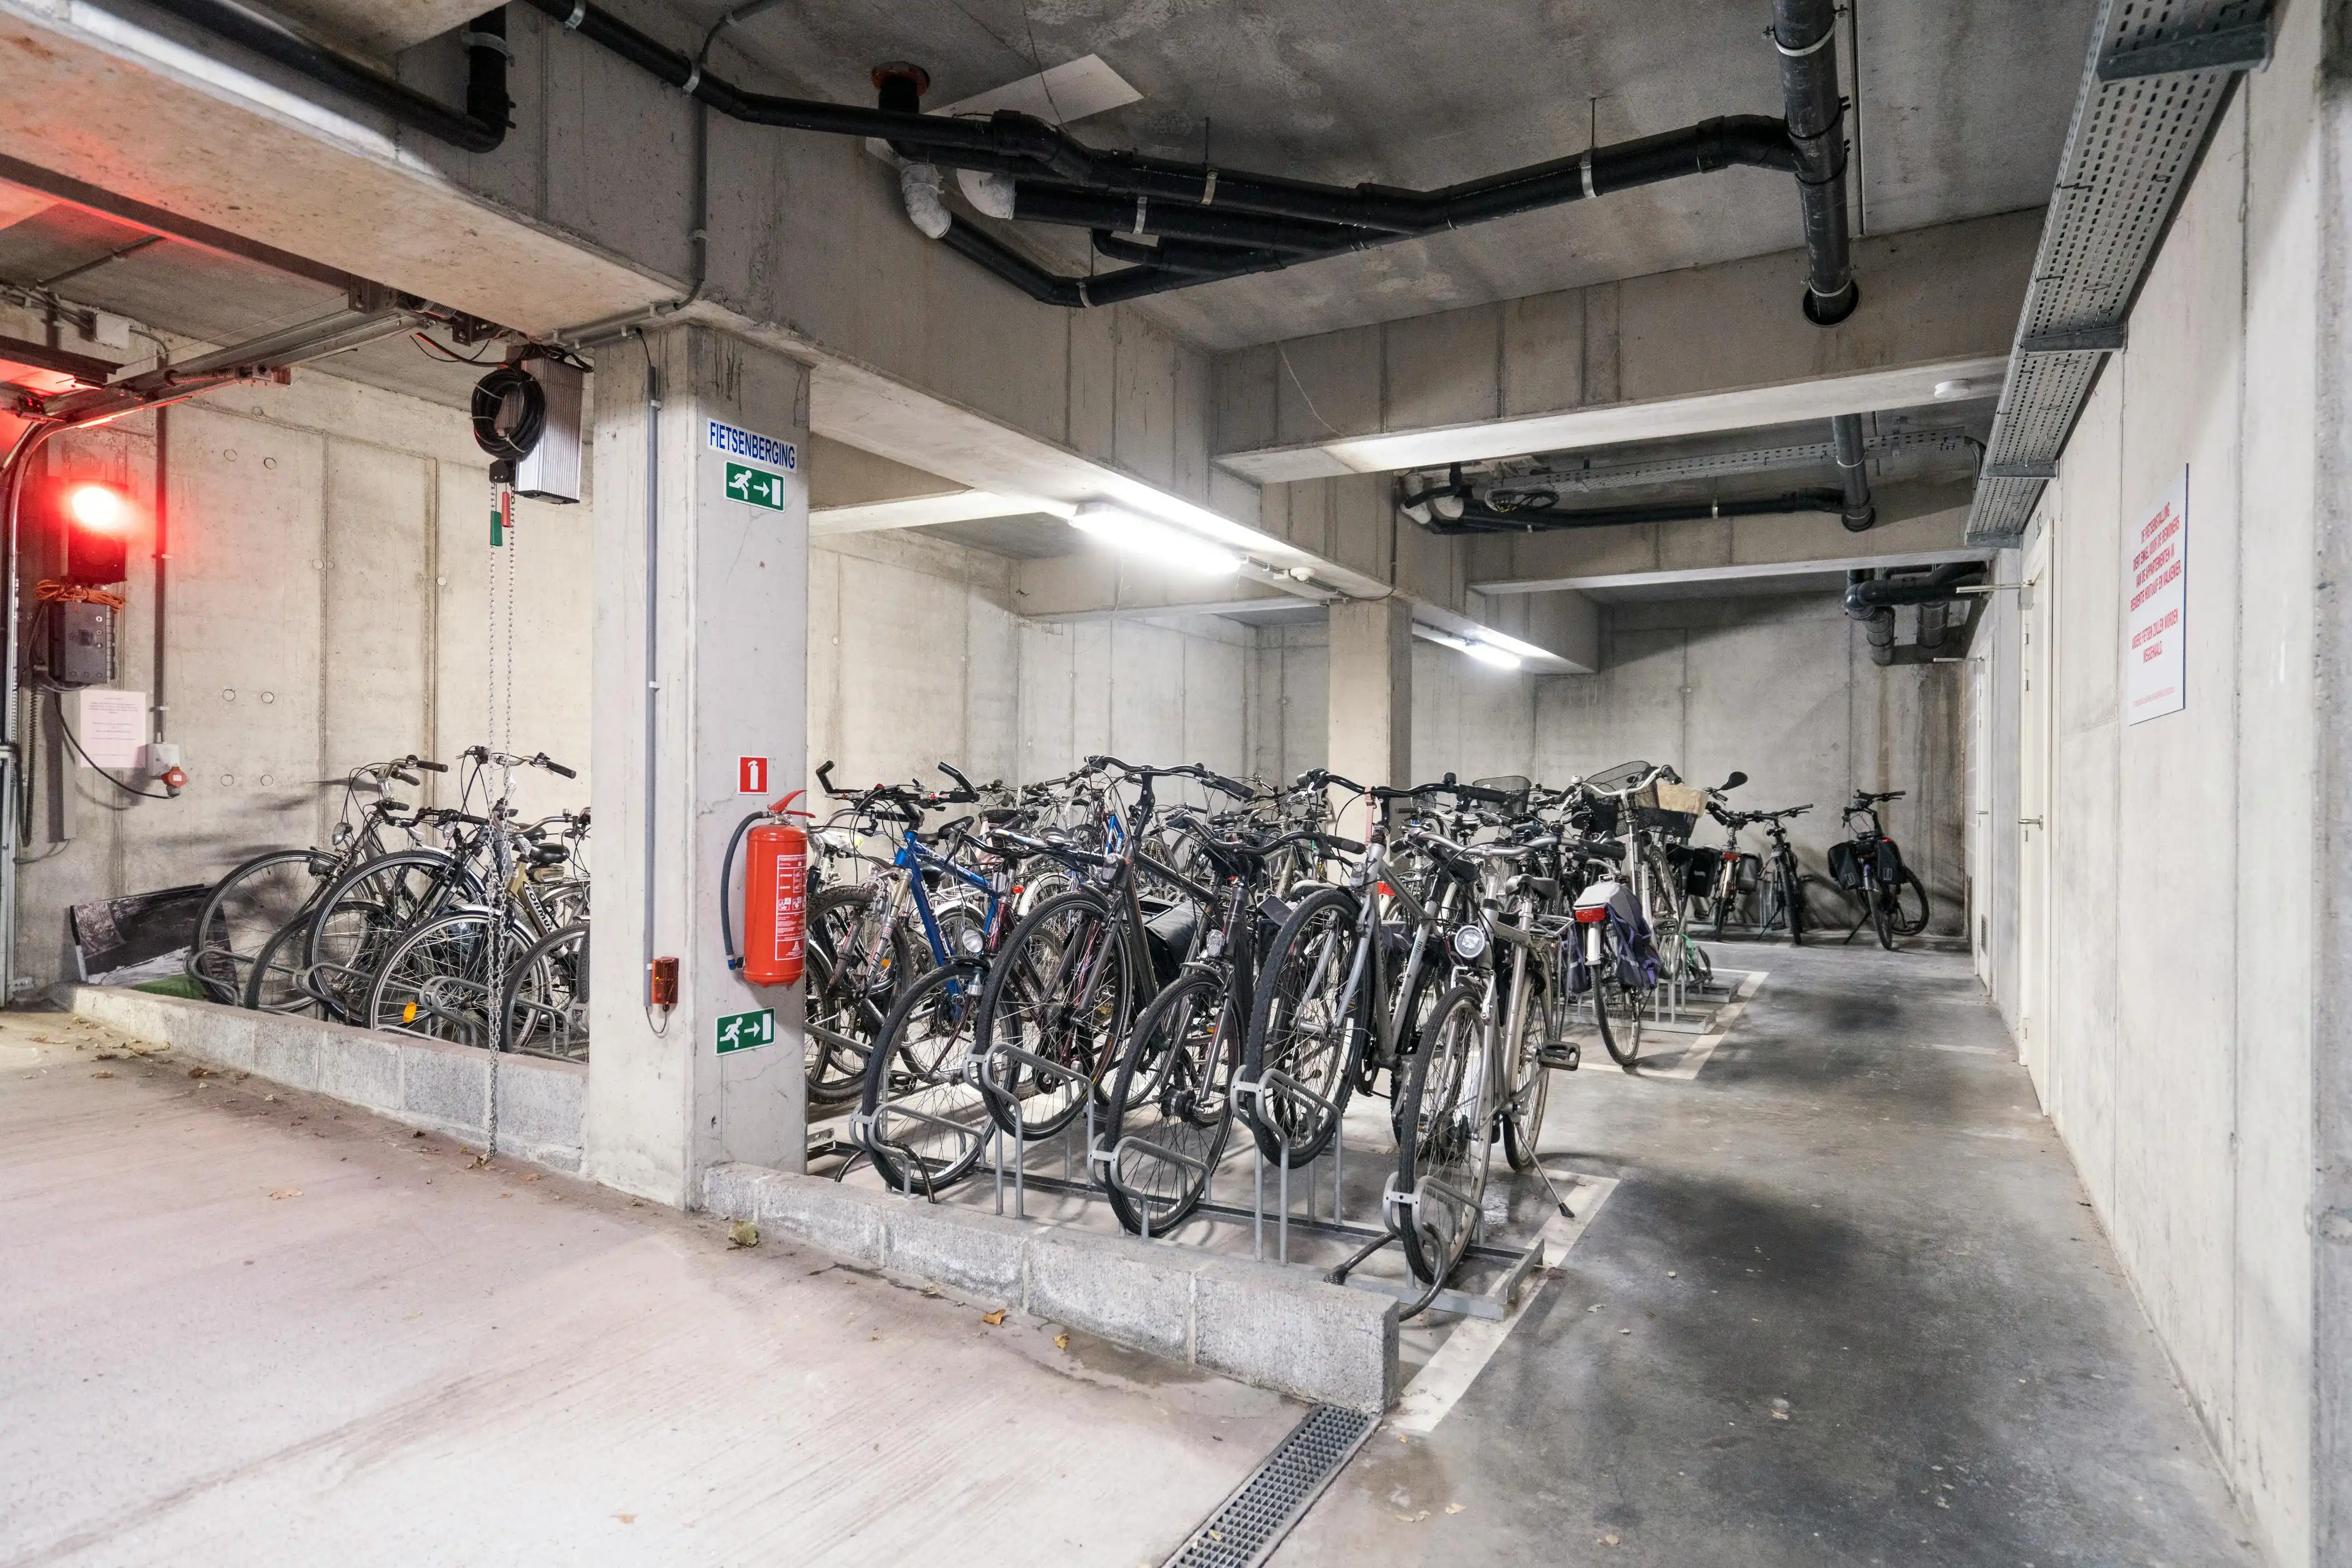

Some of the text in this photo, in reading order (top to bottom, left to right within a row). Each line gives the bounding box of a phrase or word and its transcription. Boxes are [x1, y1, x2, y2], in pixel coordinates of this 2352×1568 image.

[710, 422, 795, 469] FIETSENBERGING
[2141, 502, 2170, 544] DE FIETSENSTALLING
[2141, 545, 2149, 564] ENKEL
[2157, 531, 2161, 548] DE
[2162, 514, 2180, 544] BEWONERS
[2141, 569, 2146, 583] DE
[2146, 545, 2170, 579] APPARTEMENTEN
[2170, 542, 2174, 559] IN
[2130, 589, 2144, 612] RESIDENTIE
[2159, 574, 2163, 590] EN
[2132, 607, 2178, 650] ANDERE FIETSEN ZULLEN WORDEN
